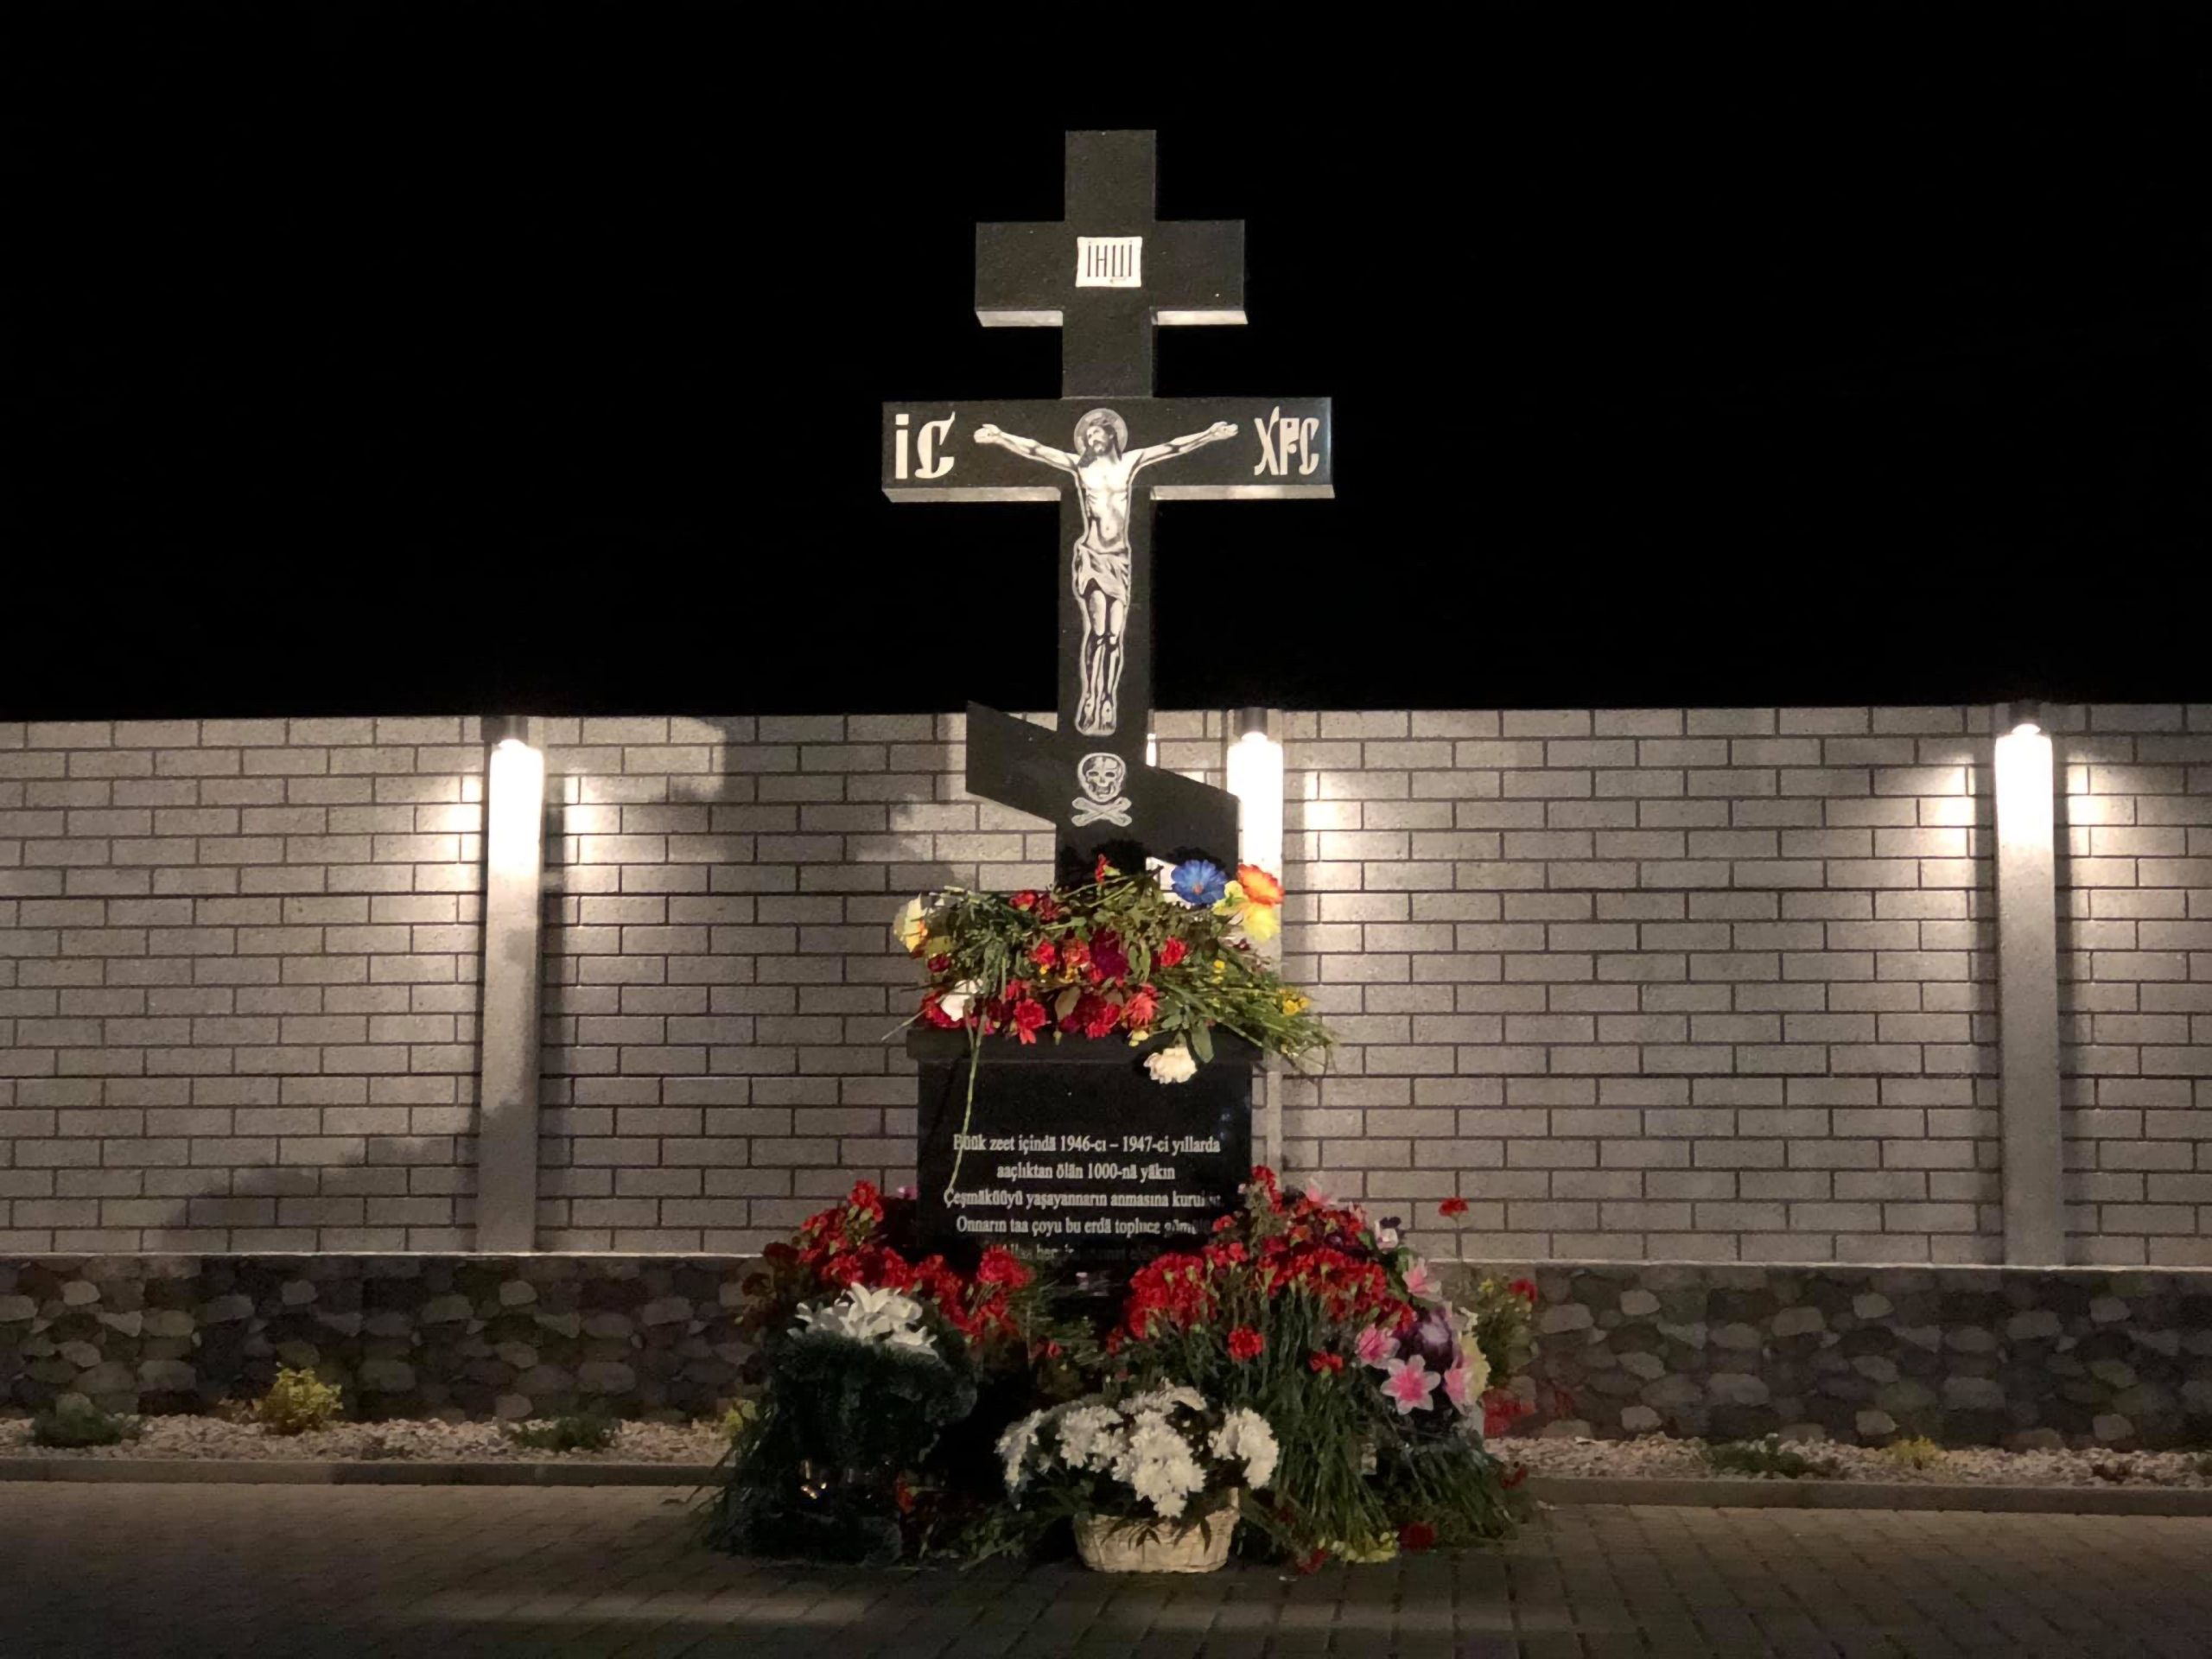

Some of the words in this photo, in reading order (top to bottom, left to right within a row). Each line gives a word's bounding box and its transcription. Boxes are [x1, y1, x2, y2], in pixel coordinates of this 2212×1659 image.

[989, 1135, 1014, 1151] zeet
[1018, 1134, 1056, 1154] içindä
[1122, 1135, 1169, 1153] 1947-ci
[1172, 1135, 1221, 1156] yıllarda
[1056, 1162, 1084, 1179] ölän
[1010, 1217, 1028, 1233] taa
[1065, 1217, 1082, 1234] bu
